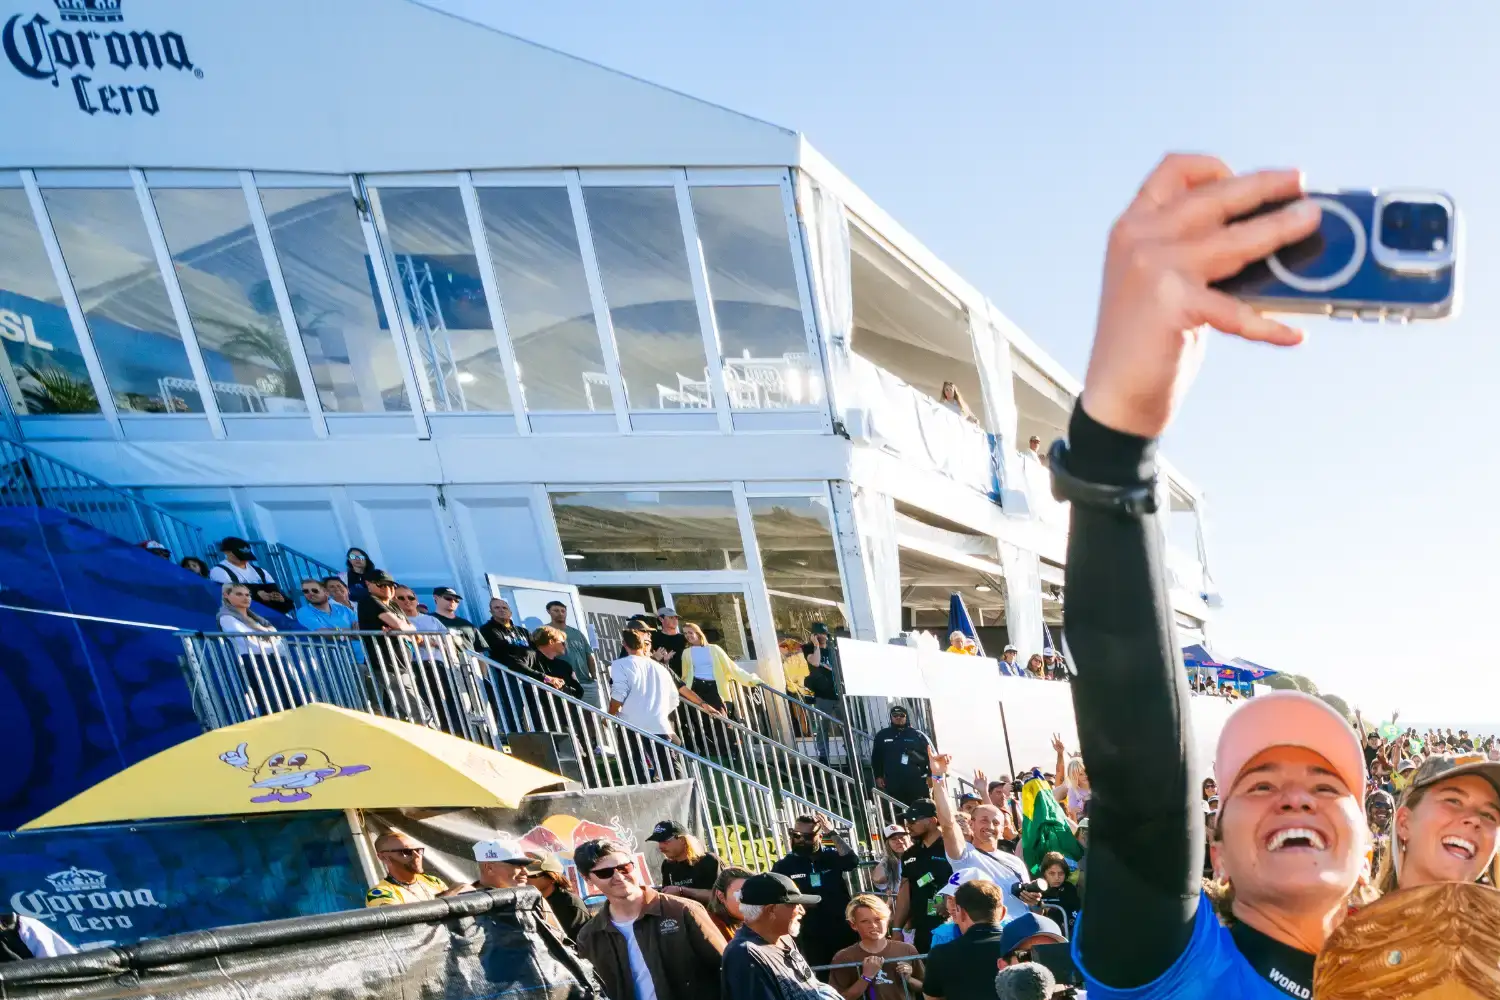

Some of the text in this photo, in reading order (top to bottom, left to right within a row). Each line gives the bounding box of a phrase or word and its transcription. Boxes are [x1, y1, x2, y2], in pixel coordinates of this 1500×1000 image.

[2, 13, 194, 88] Corona
[71, 73, 160, 116] Cero
[10, 888, 159, 922] Corona
[66, 912, 133, 933] Cero
[1269, 967, 1310, 999] WORLD
